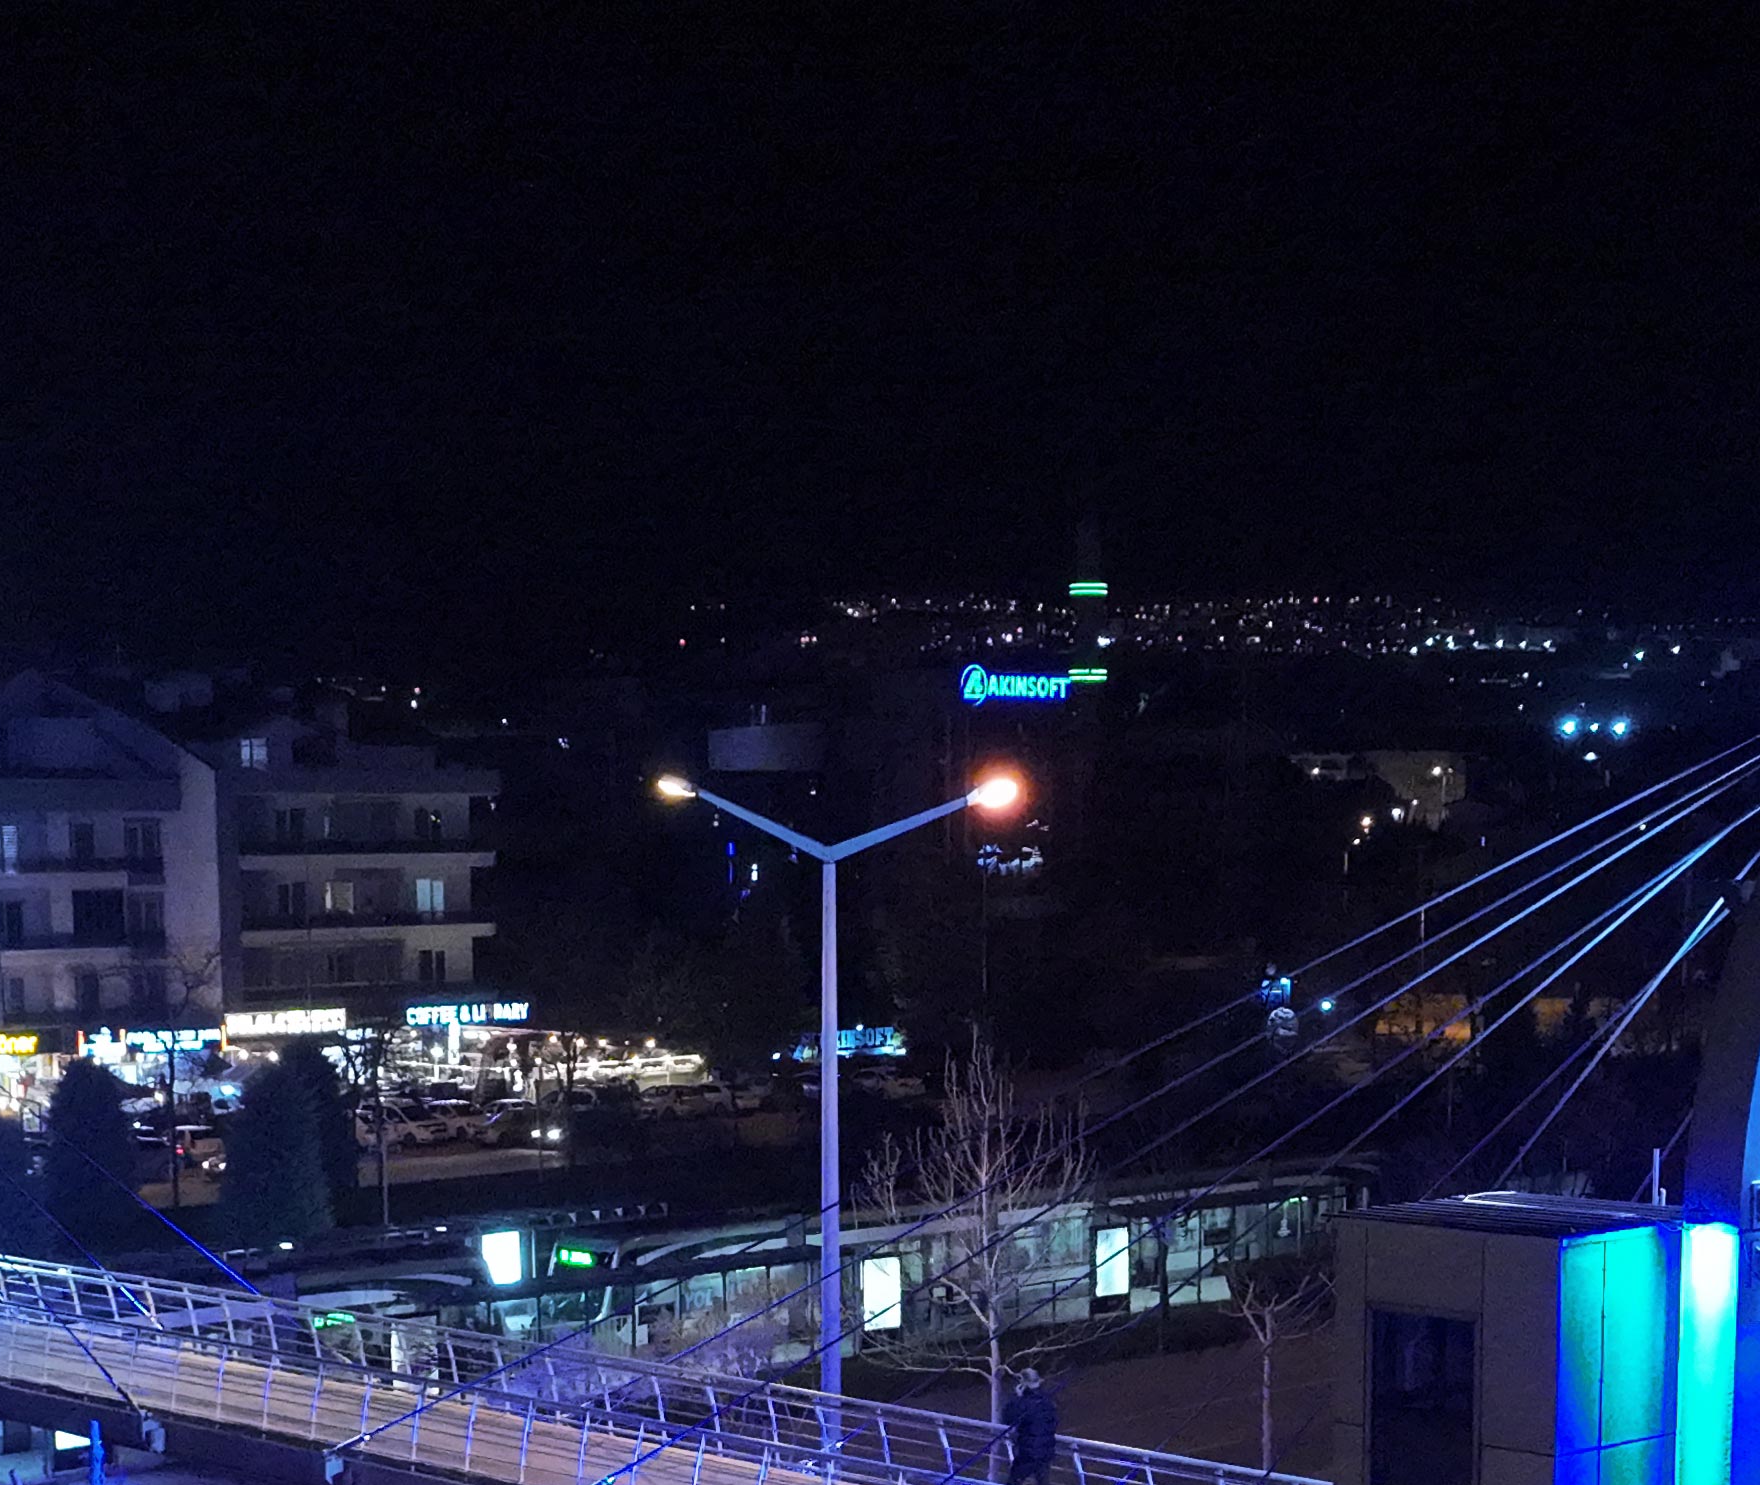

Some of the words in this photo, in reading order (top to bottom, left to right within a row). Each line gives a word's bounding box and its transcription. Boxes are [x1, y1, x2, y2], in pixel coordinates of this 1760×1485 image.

[987, 674, 1071, 699] AKINSOFT
[406, 1005, 458, 1026] COFFEE
[472, 1002, 529, 1023] LIRARY
